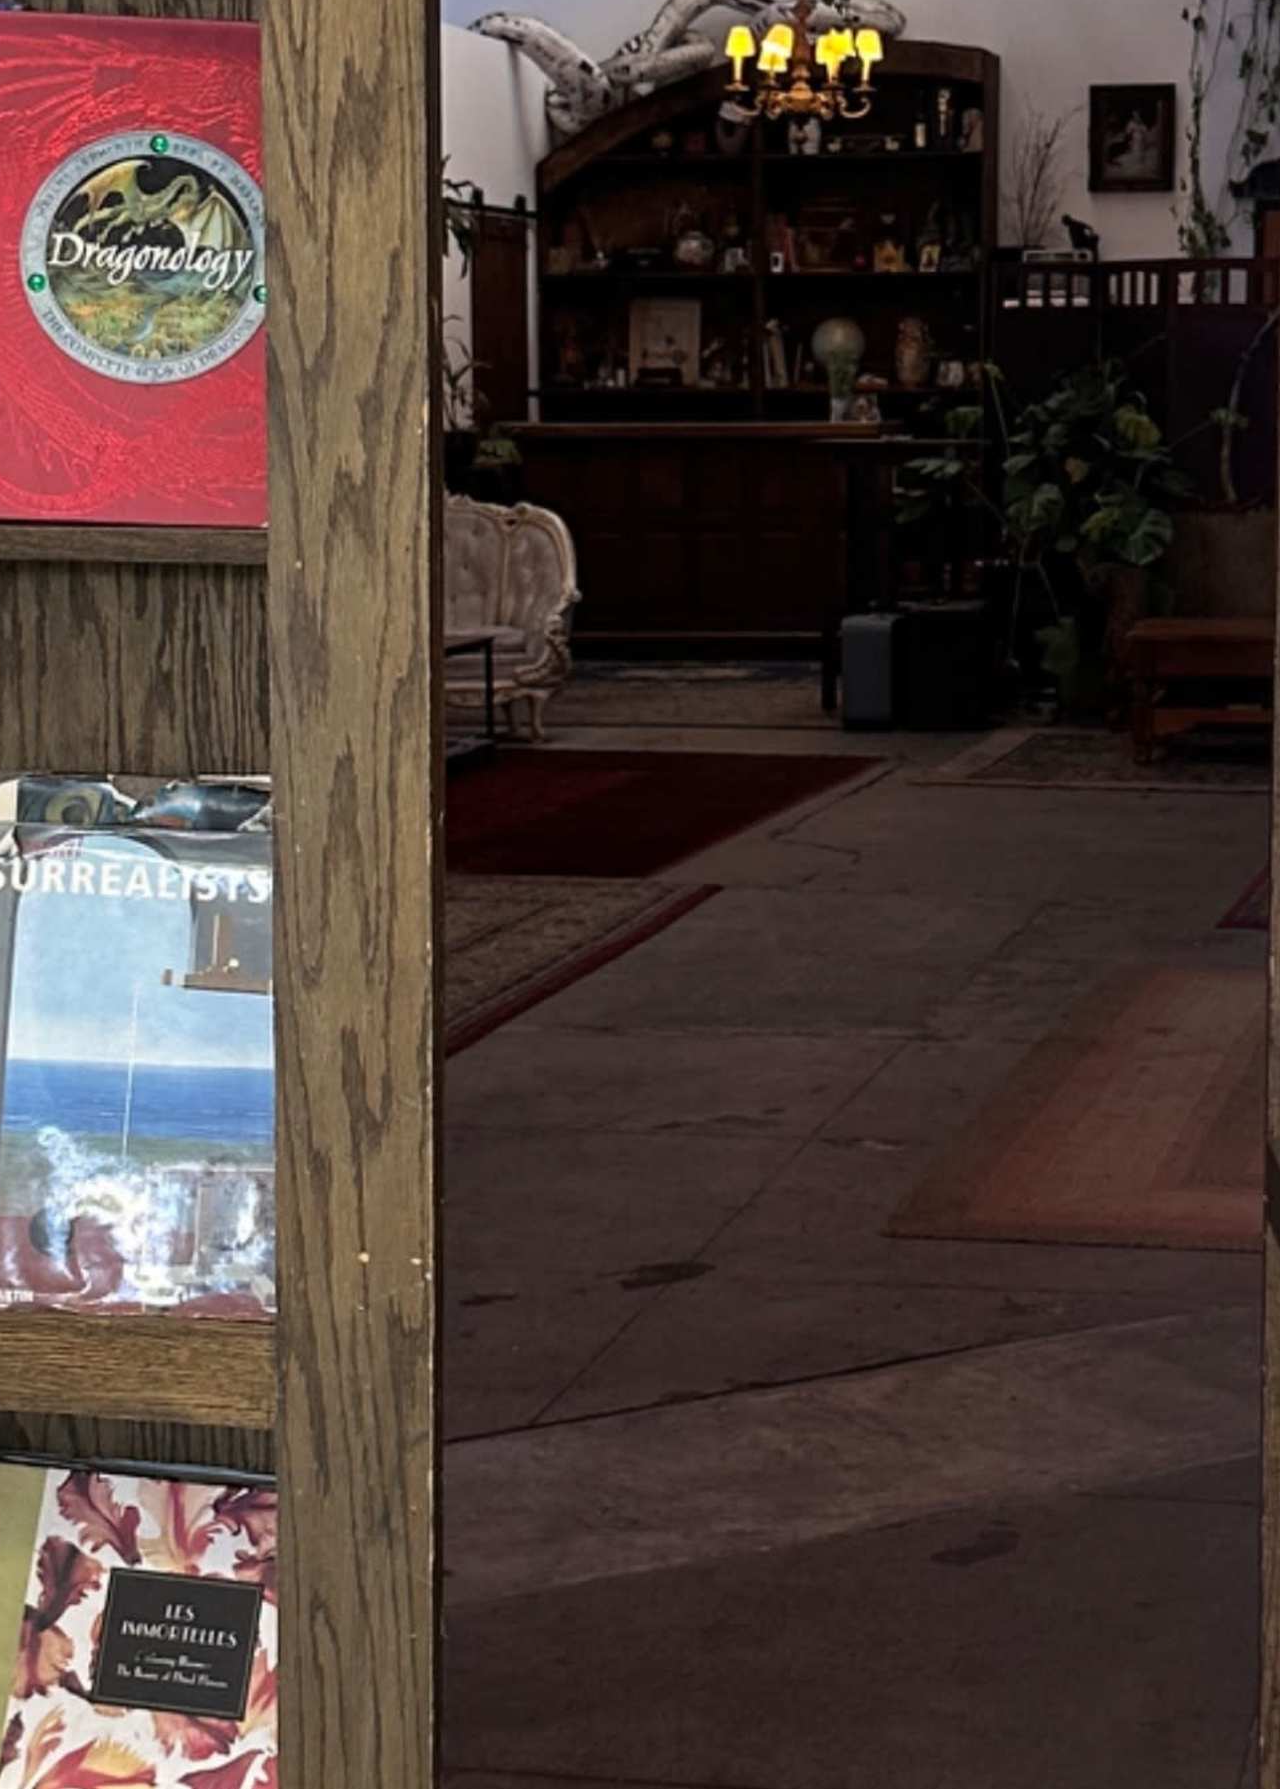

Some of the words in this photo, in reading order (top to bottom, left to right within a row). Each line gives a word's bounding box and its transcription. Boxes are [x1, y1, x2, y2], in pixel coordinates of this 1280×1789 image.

[48, 231, 255, 291] Dragonology
[163, 1603, 196, 1623] LES
[120, 1618, 239, 1651] IMMORTELLES
